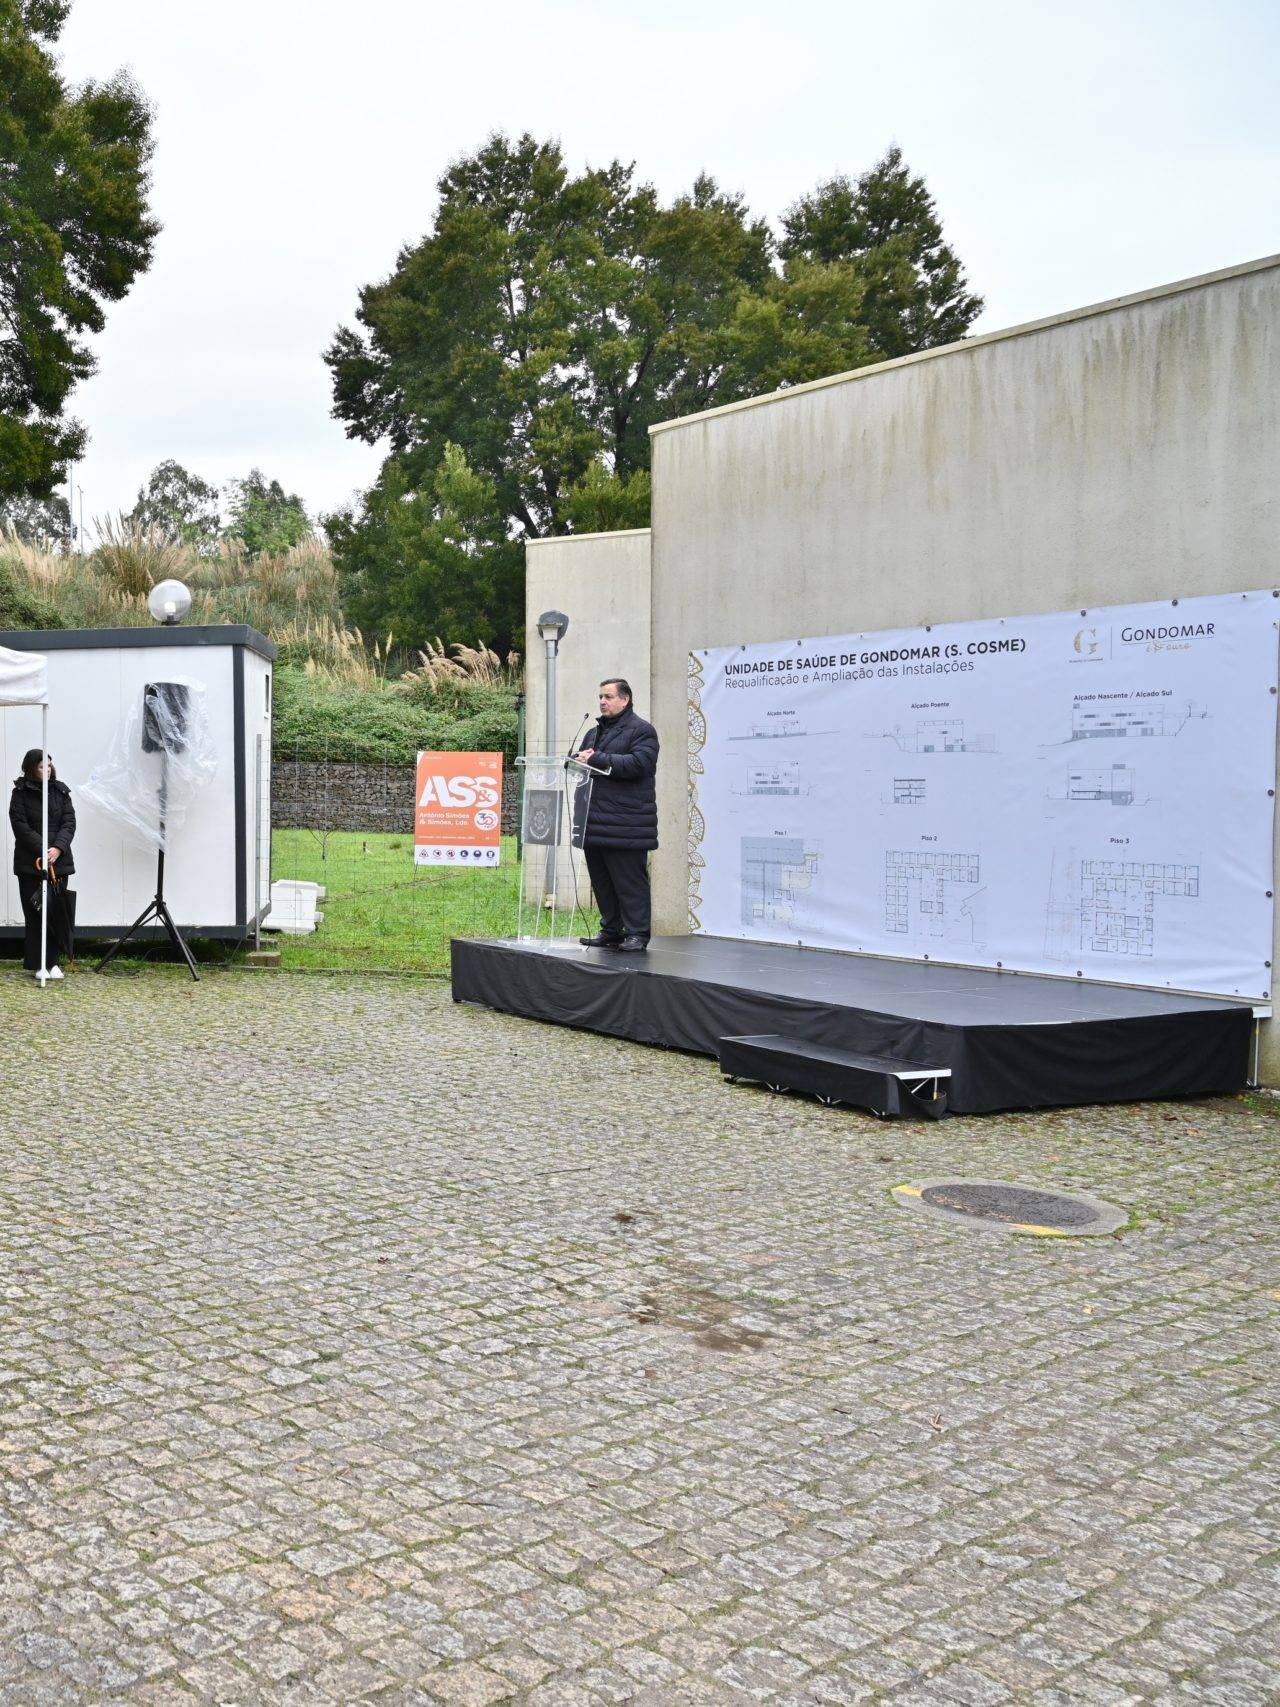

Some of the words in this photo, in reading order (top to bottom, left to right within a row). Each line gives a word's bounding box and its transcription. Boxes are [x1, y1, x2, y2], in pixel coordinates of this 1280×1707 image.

[1121, 623, 1215, 642] GONDOMAR
[725, 661, 774, 675] UNIDADE
[778, 659, 793, 671] DE
[796, 654, 836, 670] SAÚDE
[840, 653, 857, 666] DE
[860, 646, 940, 664] GONDOMAR
[945, 644, 962, 658] (S.
[967, 638, 1026, 655] COSME)
[725, 674, 800, 689] Requalificação
[803, 675, 809, 683] e
[813, 667, 873, 683] Ampliação
[877, 666, 898, 678] das
[902, 660, 974, 675] Instalações
[1136, 690, 1160, 698] Alçado
[419, 775, 499, 808] ASS
